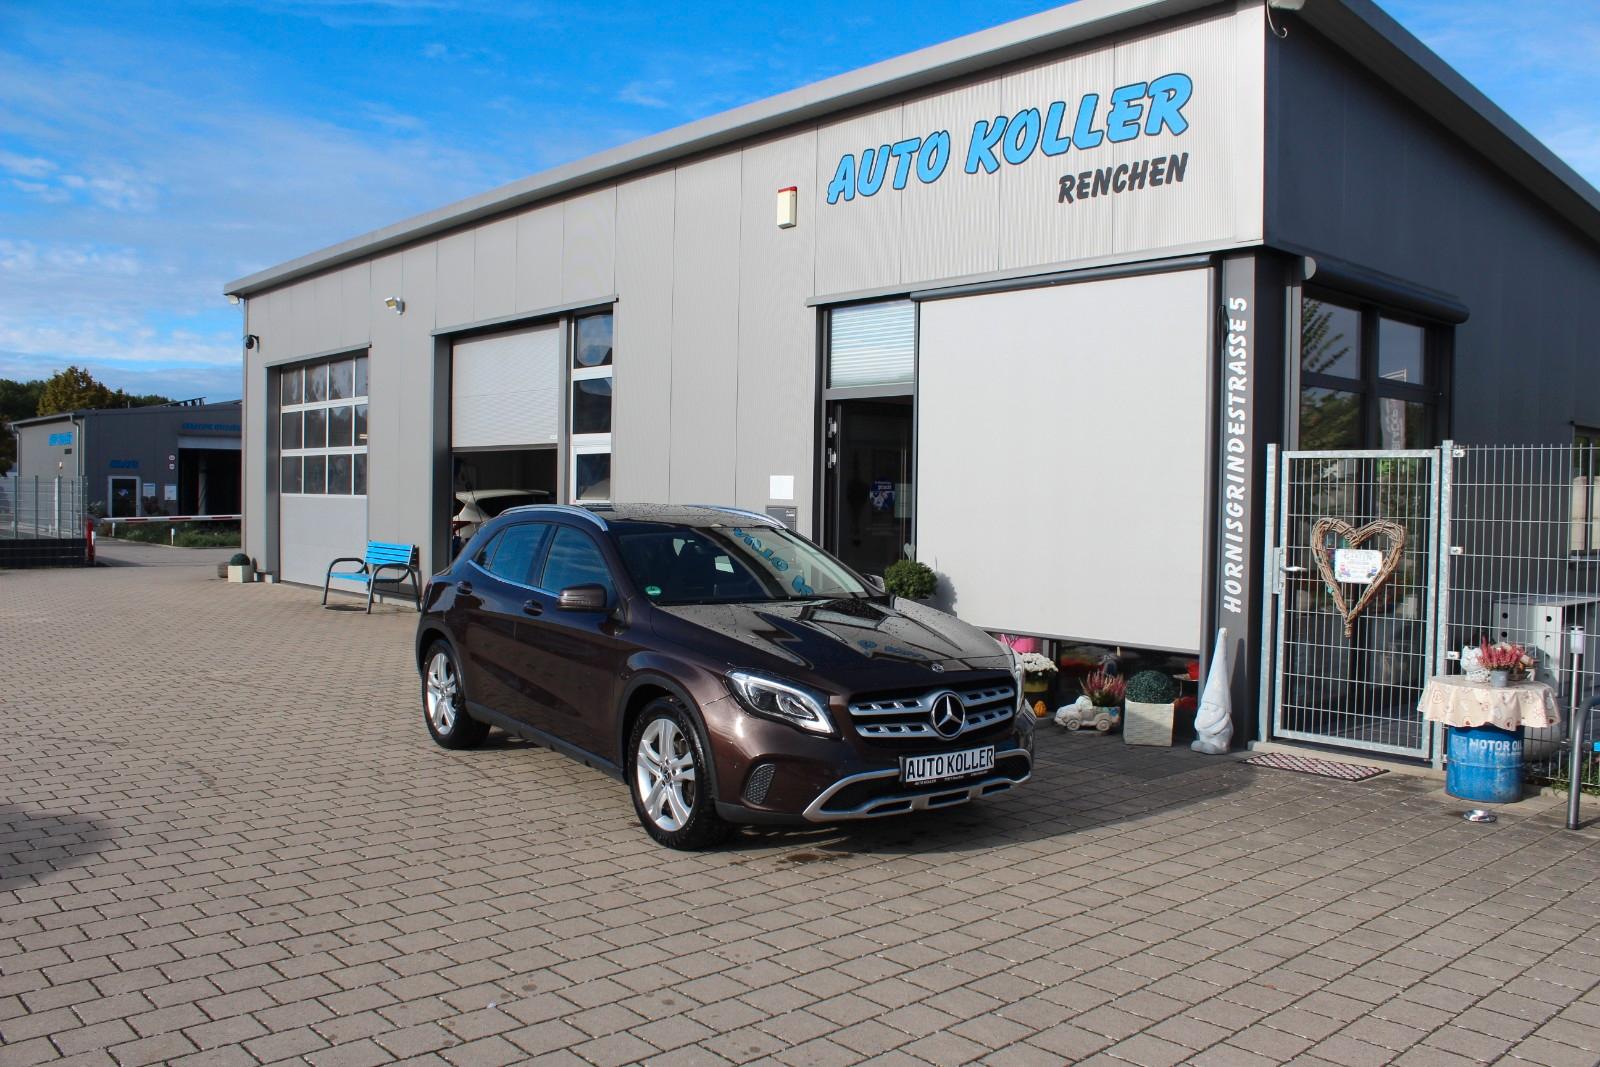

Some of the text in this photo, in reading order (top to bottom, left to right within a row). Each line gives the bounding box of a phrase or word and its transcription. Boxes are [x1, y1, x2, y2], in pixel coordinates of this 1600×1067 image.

[827, 72, 1194, 205] AUTO KOLLER
[1058, 152, 1189, 204] RENCHEN
[1223, 297, 1248, 614] HORNISGRINDESTRASSE 5
[907, 748, 993, 779] AUTO KOLLER
[1469, 738, 1510, 751] MOTOR
